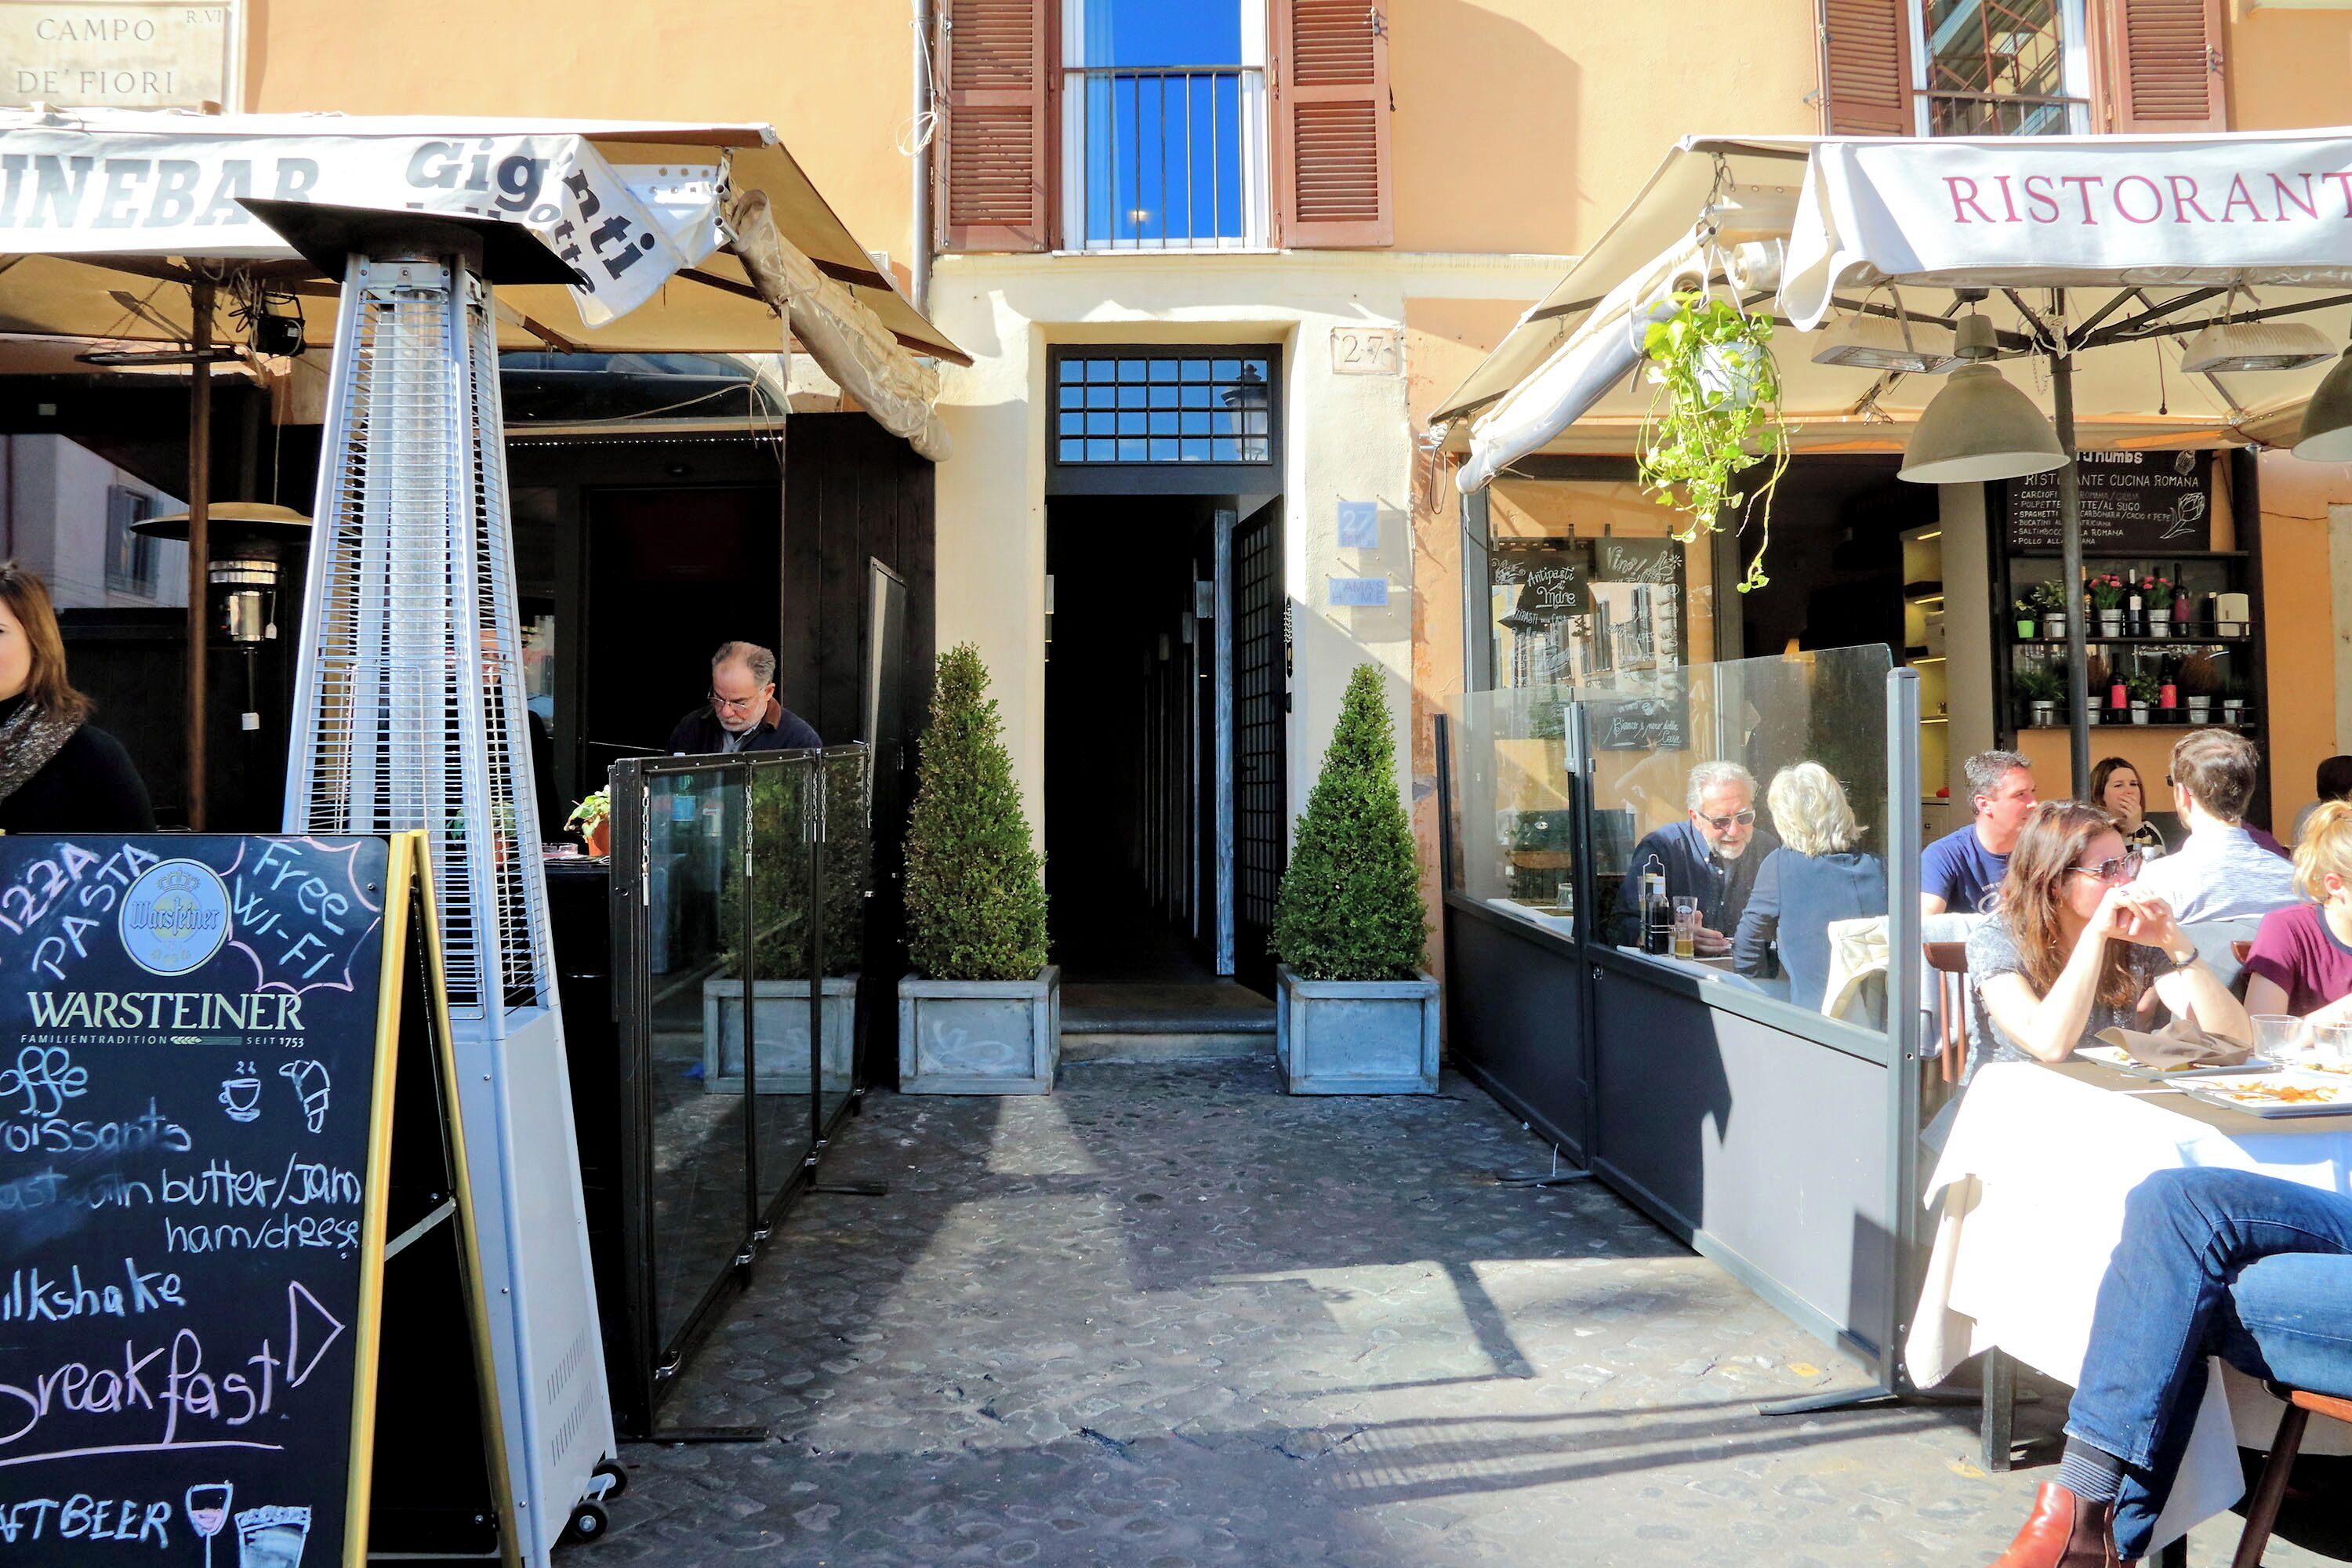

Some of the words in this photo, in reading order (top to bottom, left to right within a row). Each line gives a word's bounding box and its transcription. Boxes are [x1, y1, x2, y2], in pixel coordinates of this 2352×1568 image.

[36, 18, 155, 41] CAMPO
[79, 71, 172, 93] FIORI
[405, 136, 655, 281] Gignti
[1341, 335, 1385, 364] 27
[2024, 473, 2105, 486] RISTNTE
[2110, 474, 2150, 487] CUCINA
[2154, 475, 2199, 487] ROMANA
[1341, 510, 1373, 532] 27
[1526, 566, 1575, 587] Antipasti
[31, 843, 160, 981] PASTA
[130, 896, 220, 936] Warsteiner
[27, 992, 306, 1031] WARSTEINER
[20, 1034, 168, 1044] FAMILIENTRADITION
[246, 1036, 276, 1045] SEIT
[279, 1036, 305, 1048] 1753
[0, 1096, 192, 1152] oissants
[60, 1494, 172, 1549] BEER
